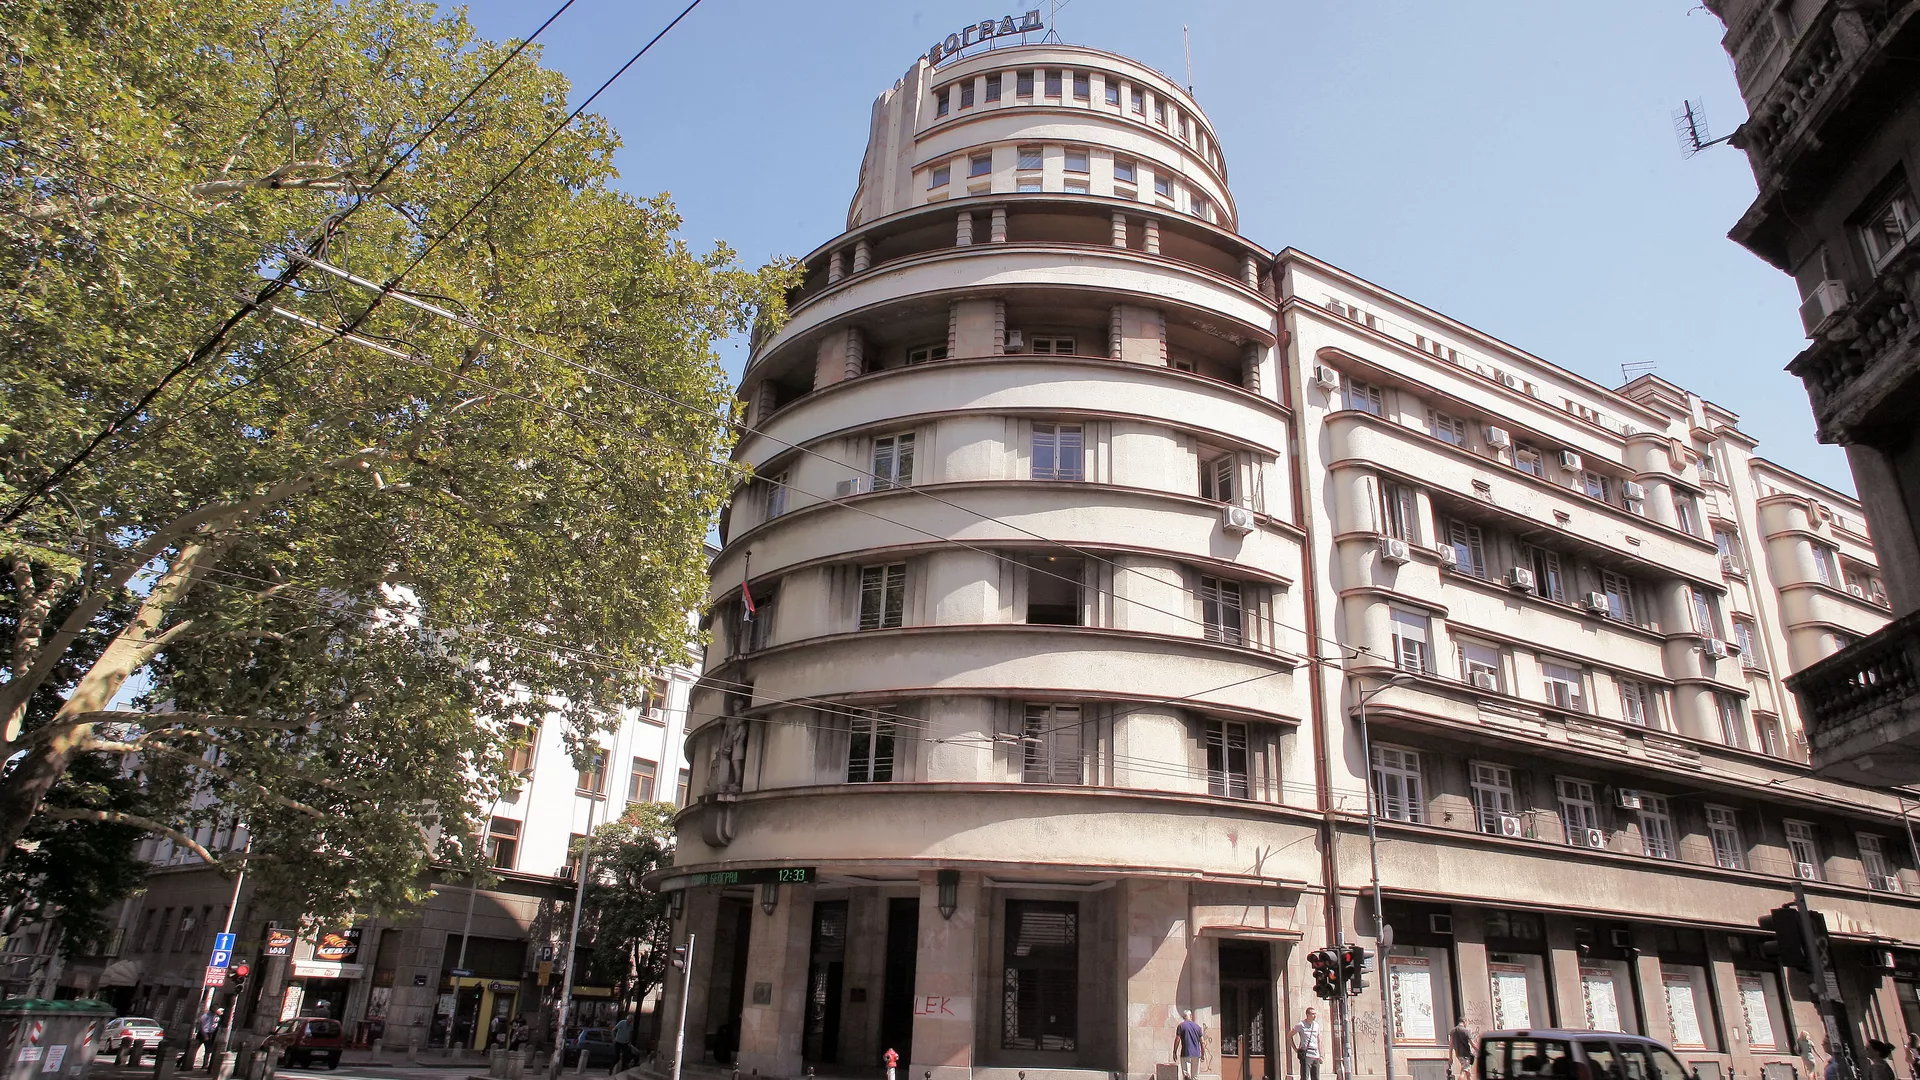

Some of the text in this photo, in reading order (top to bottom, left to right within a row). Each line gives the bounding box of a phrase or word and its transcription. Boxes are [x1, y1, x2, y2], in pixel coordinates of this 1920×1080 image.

[917, 9, 1044, 66] ЕОГРАД
[710, 872, 738, 885] БЕОГРАД
[779, 869, 805, 882] 12:33
[317, 947, 357, 955] KEBAB
[544, 948, 551, 960] P
[213, 951, 227, 966] P
[914, 996, 955, 1016] LEK
